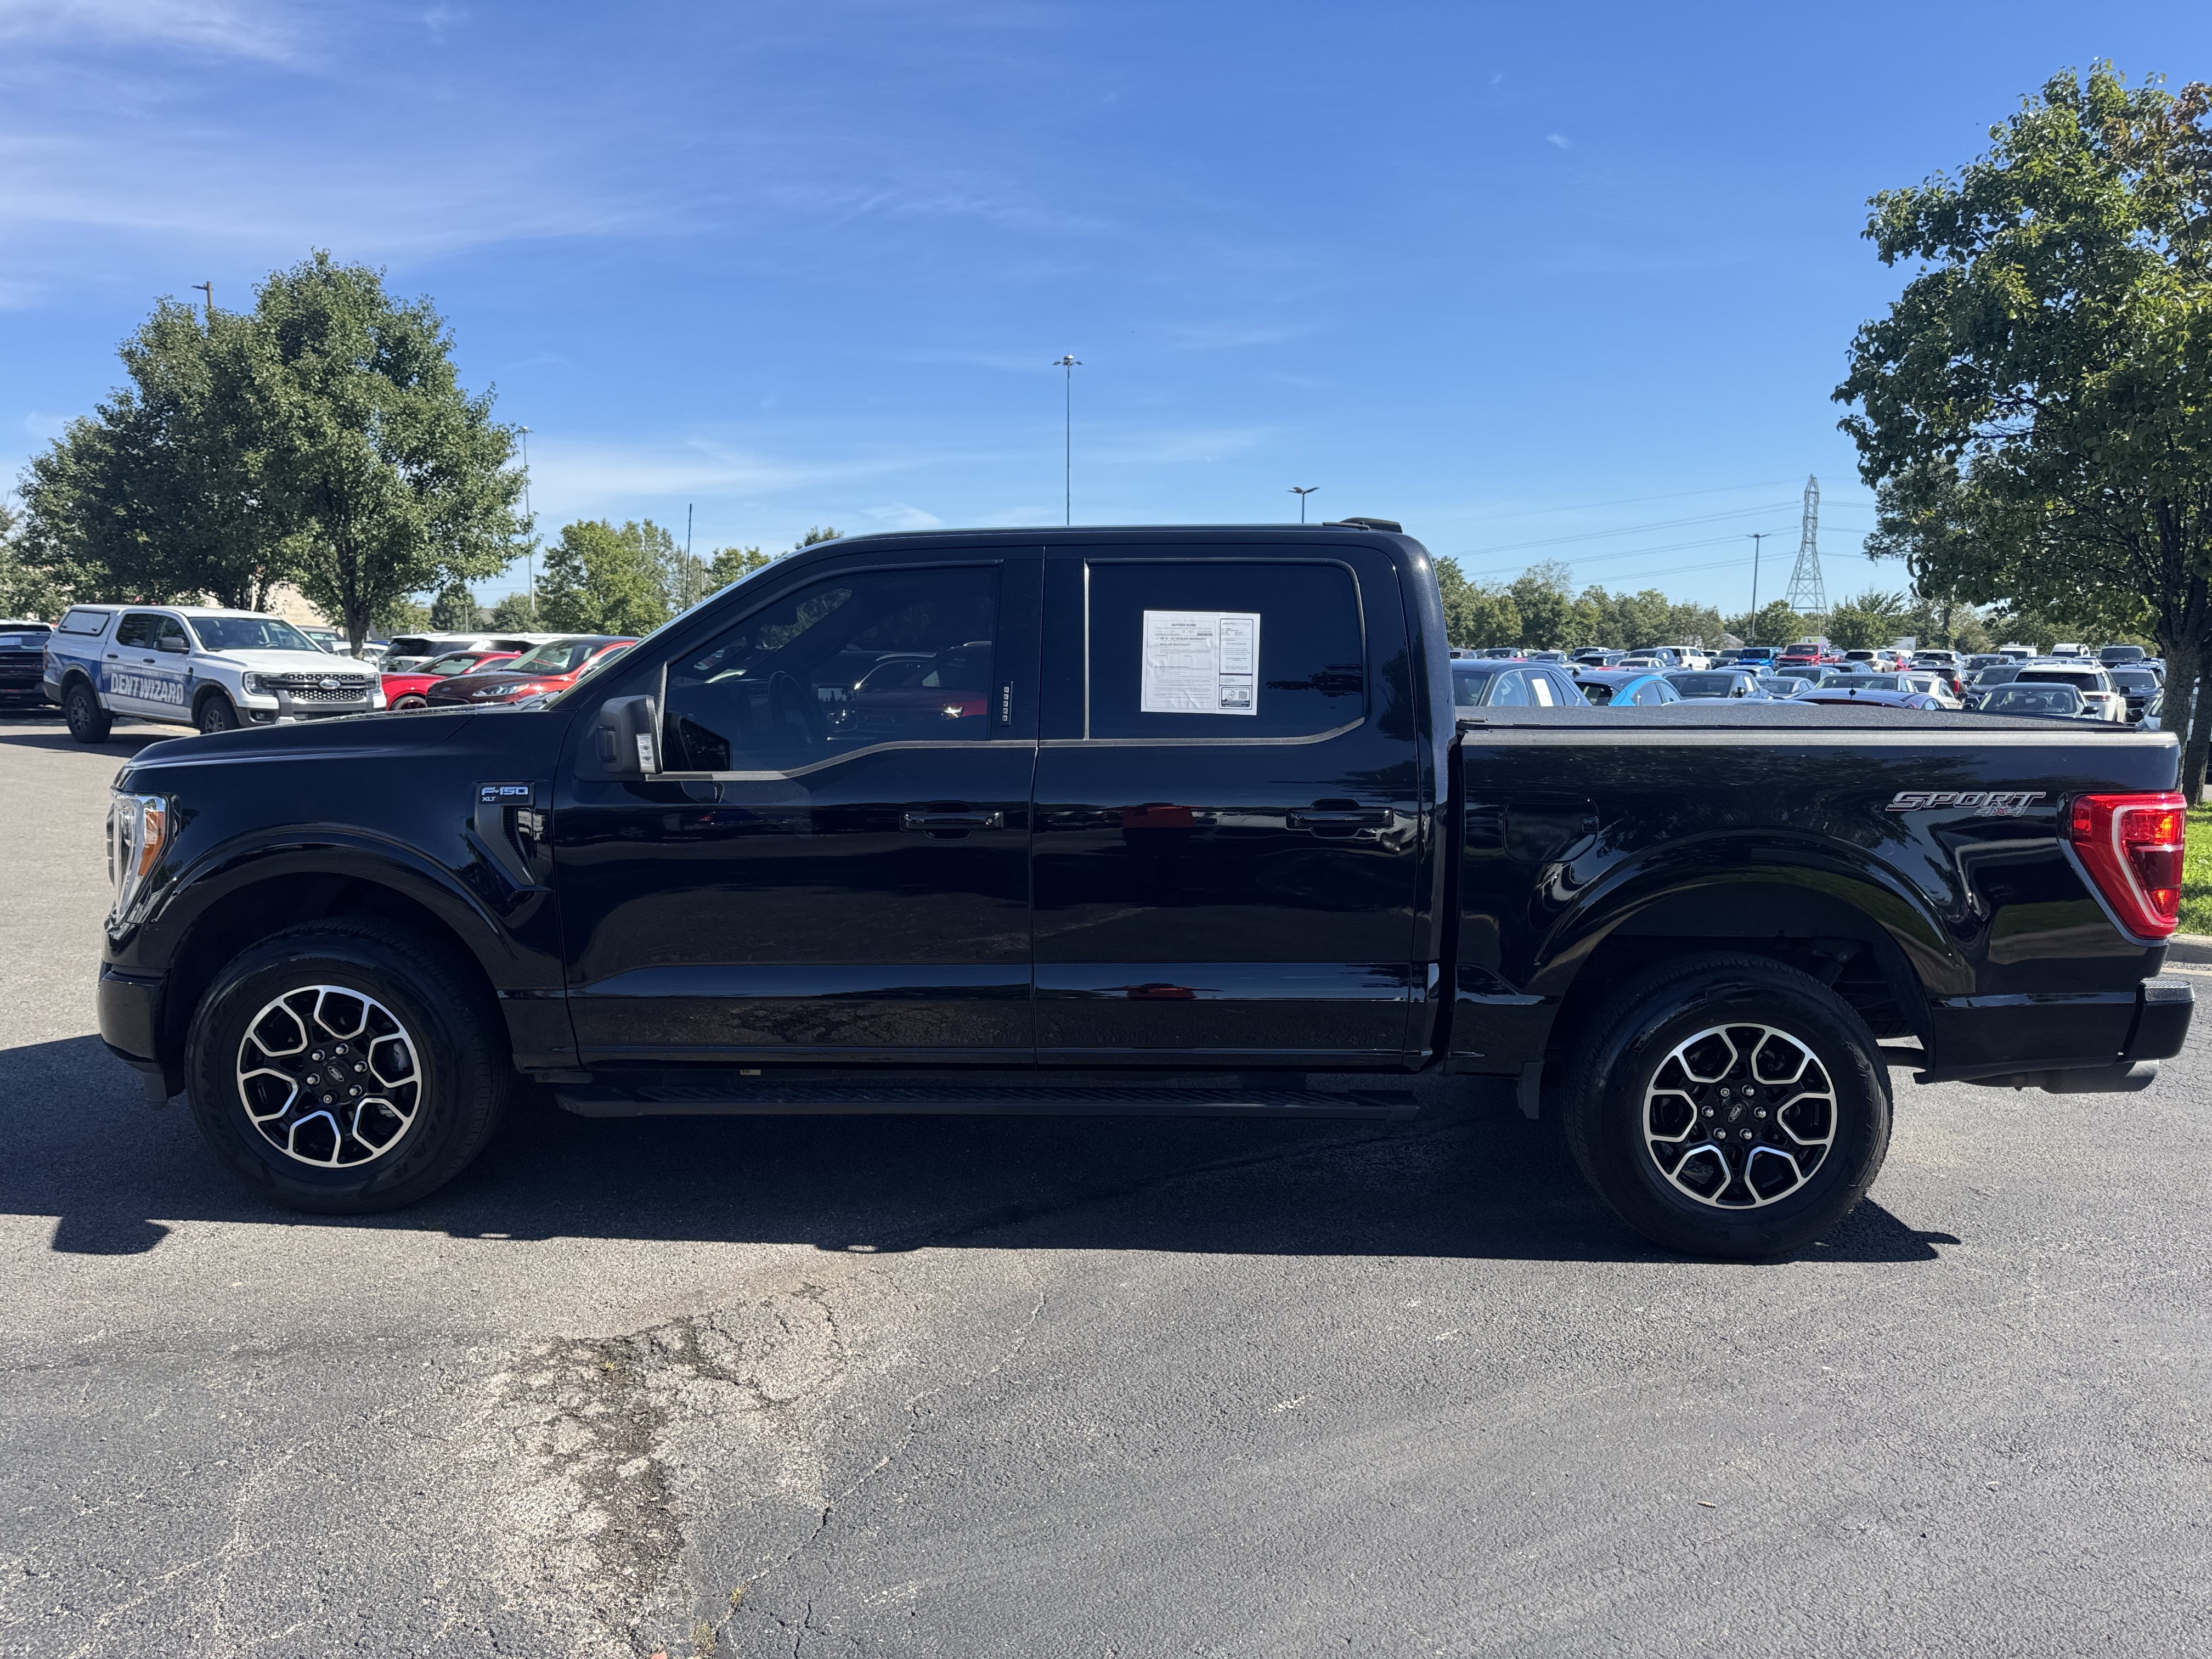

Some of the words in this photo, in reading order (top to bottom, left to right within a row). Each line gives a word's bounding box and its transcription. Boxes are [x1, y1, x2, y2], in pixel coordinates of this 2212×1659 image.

[110, 673, 140, 697] DENT
[139, 677, 184, 705] WIZARD
[481, 786, 528, 795] F-150
[1884, 791, 2047, 811] SPORT
[1973, 807, 2027, 817] 4x4
